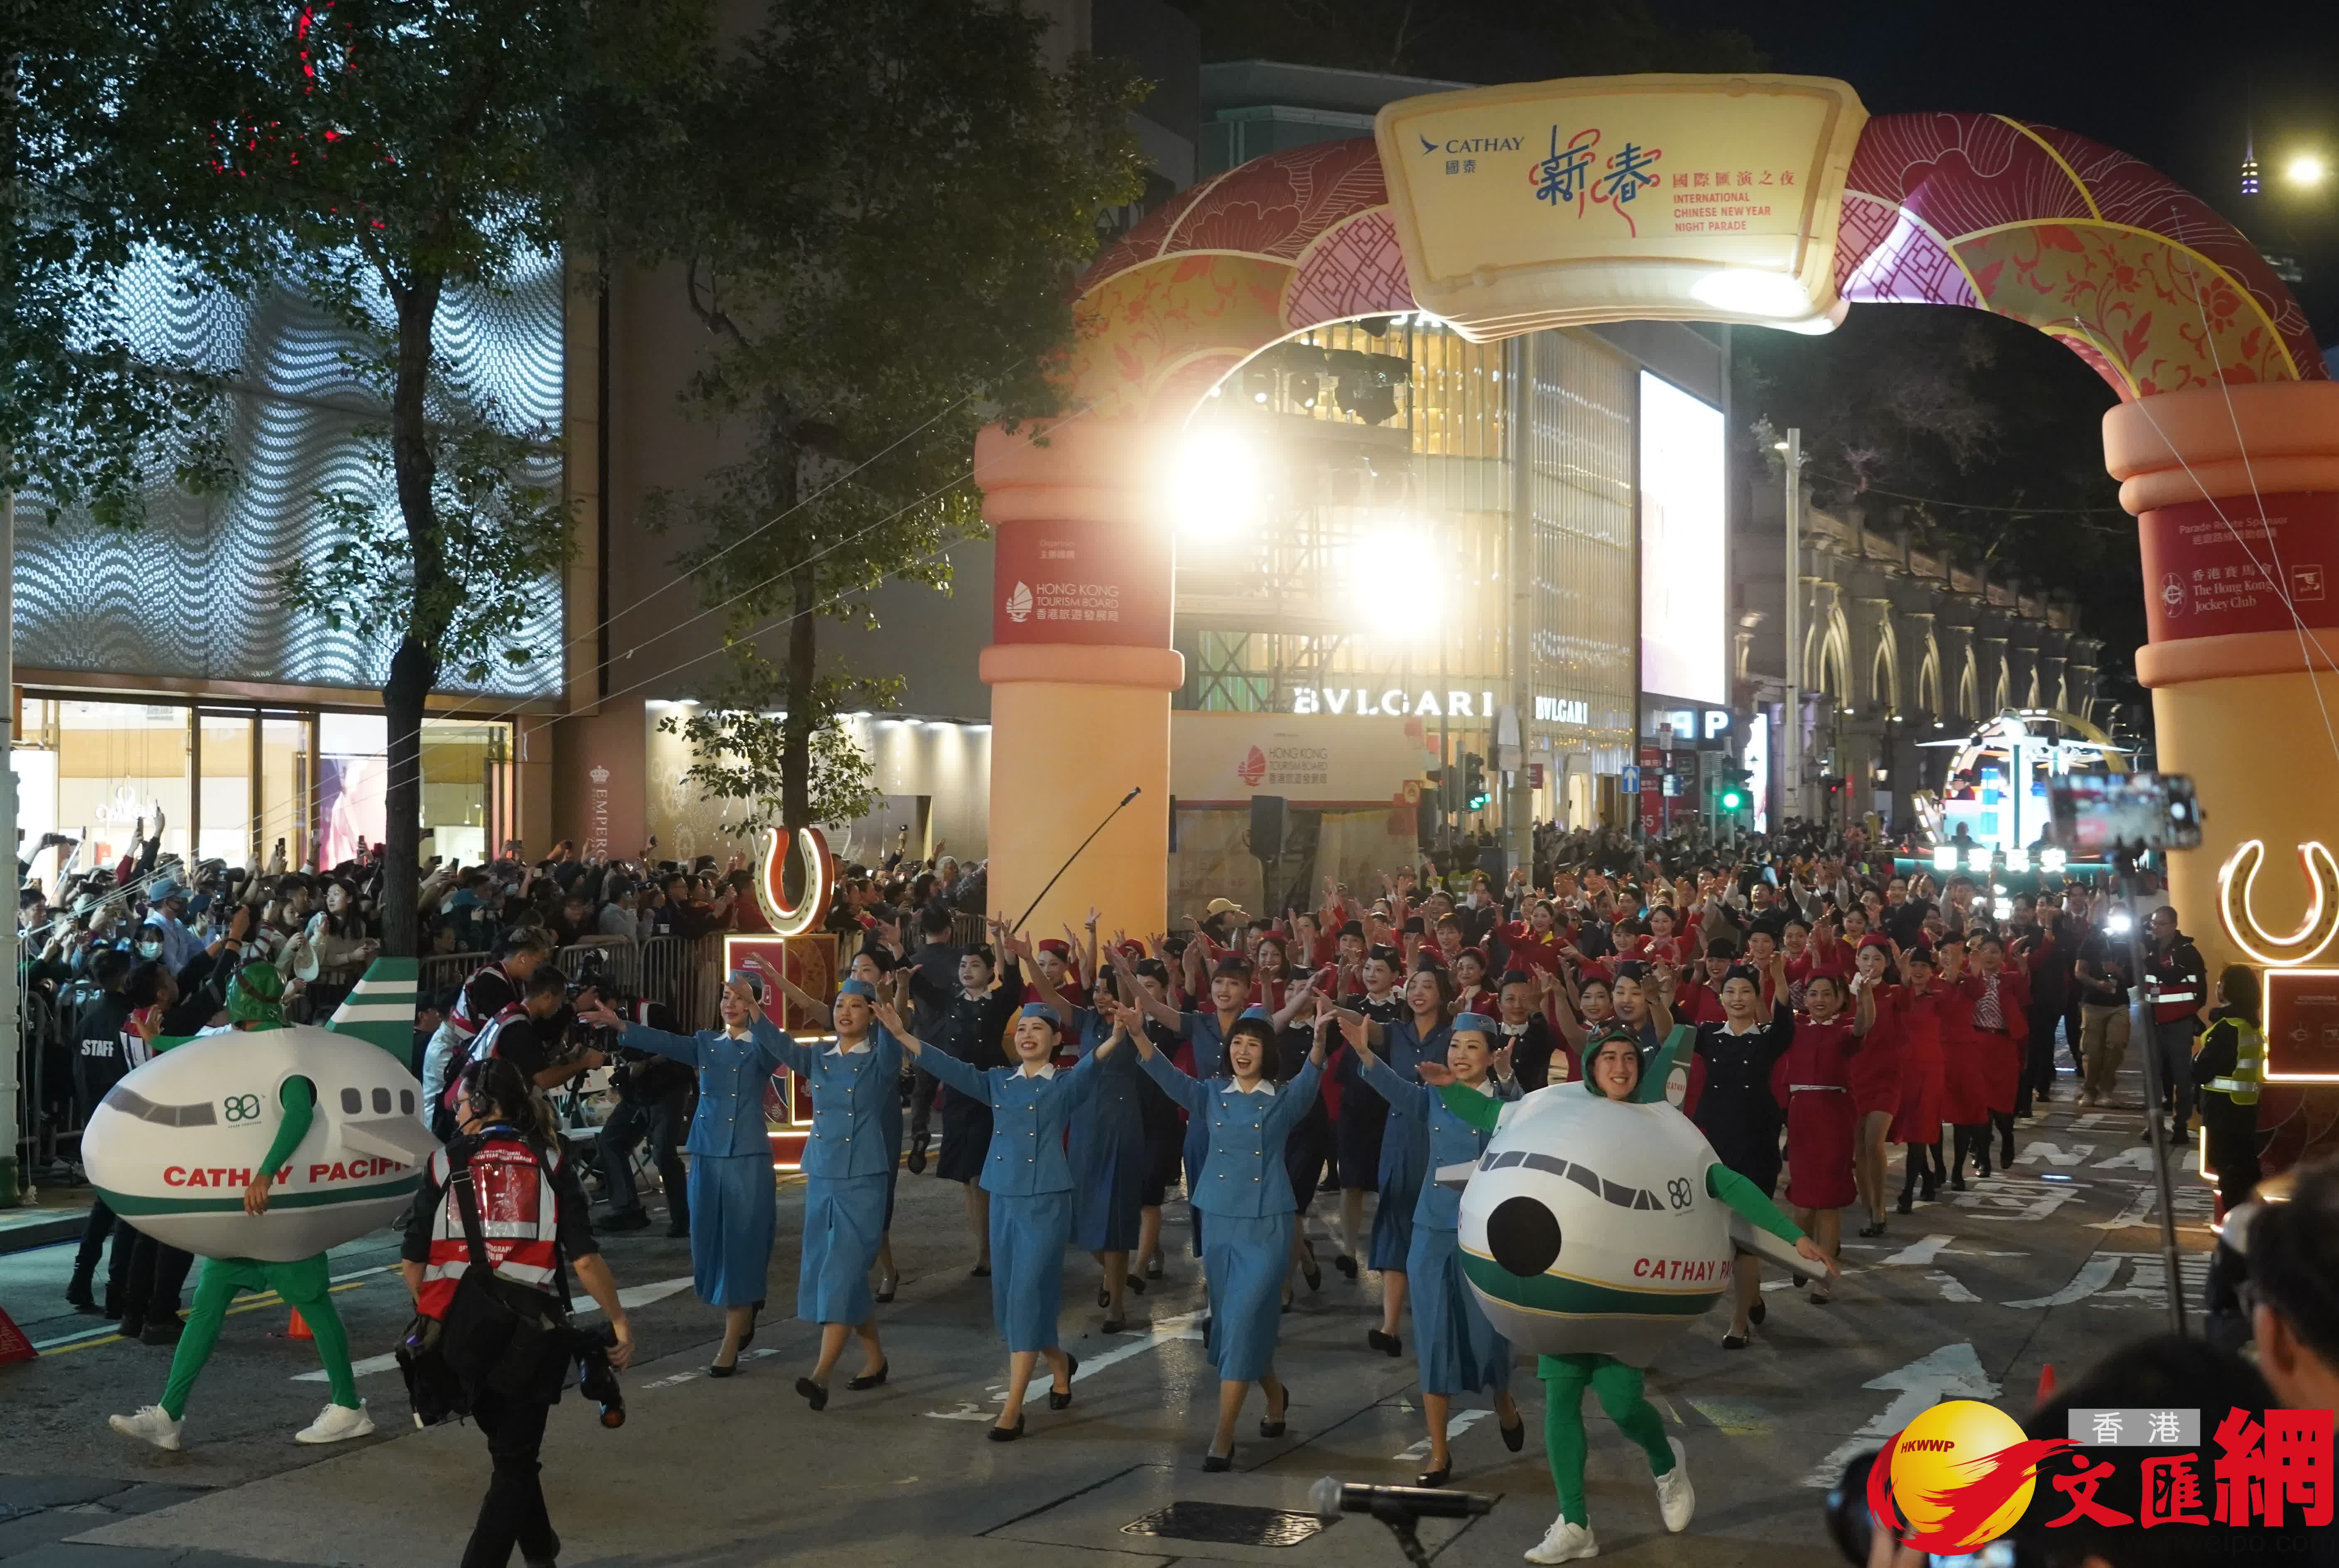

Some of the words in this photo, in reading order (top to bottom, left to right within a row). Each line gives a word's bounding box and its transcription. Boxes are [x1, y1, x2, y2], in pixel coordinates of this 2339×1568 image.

[1445, 136, 1525, 154] CATHAY
[1445, 159, 1476, 175] 國泰
[1530, 124, 1661, 208] 新春
[1673, 170, 1796, 188] 國際匯演之夜
[1674, 192, 1751, 204] INTERNATIONAL
[1674, 208, 1717, 218] CHINESE
[1721, 207, 1743, 217] NEW
[1747, 206, 1771, 216] YEAR
[1676, 222, 1705, 232] NIGHT
[1709, 221, 1747, 231] PARADE
[2179, 522, 2212, 534] Parade
[2191, 563, 2272, 582] 香港賽馬會
[1036, 583, 1076, 595] HONG
[1080, 584, 1119, 597] KONG
[2193, 584, 2212, 596] The
[2214, 582, 2243, 595] Hong
[2245, 580, 2273, 592] Kong
[1037, 597, 1081, 607] TOURISM
[1083, 598, 1119, 609] BOARD
[2194, 598, 2228, 615] Jockey
[2231, 596, 2257, 608] Club
[1294, 687, 1493, 716] BVLGARI
[1535, 696, 1588, 724] BVLGARI
[1705, 711, 1728, 739] P
[1269, 747, 1298, 758] HONG
[1300, 748, 1328, 759] KONG
[81, 1039, 114, 1057] STAFF
[224, 1094, 260, 1122] 80
[163, 1166, 293, 1187] CATHY
[1667, 1177, 1692, 1209] 80
[1633, 1258, 1715, 1281] CATHAY
